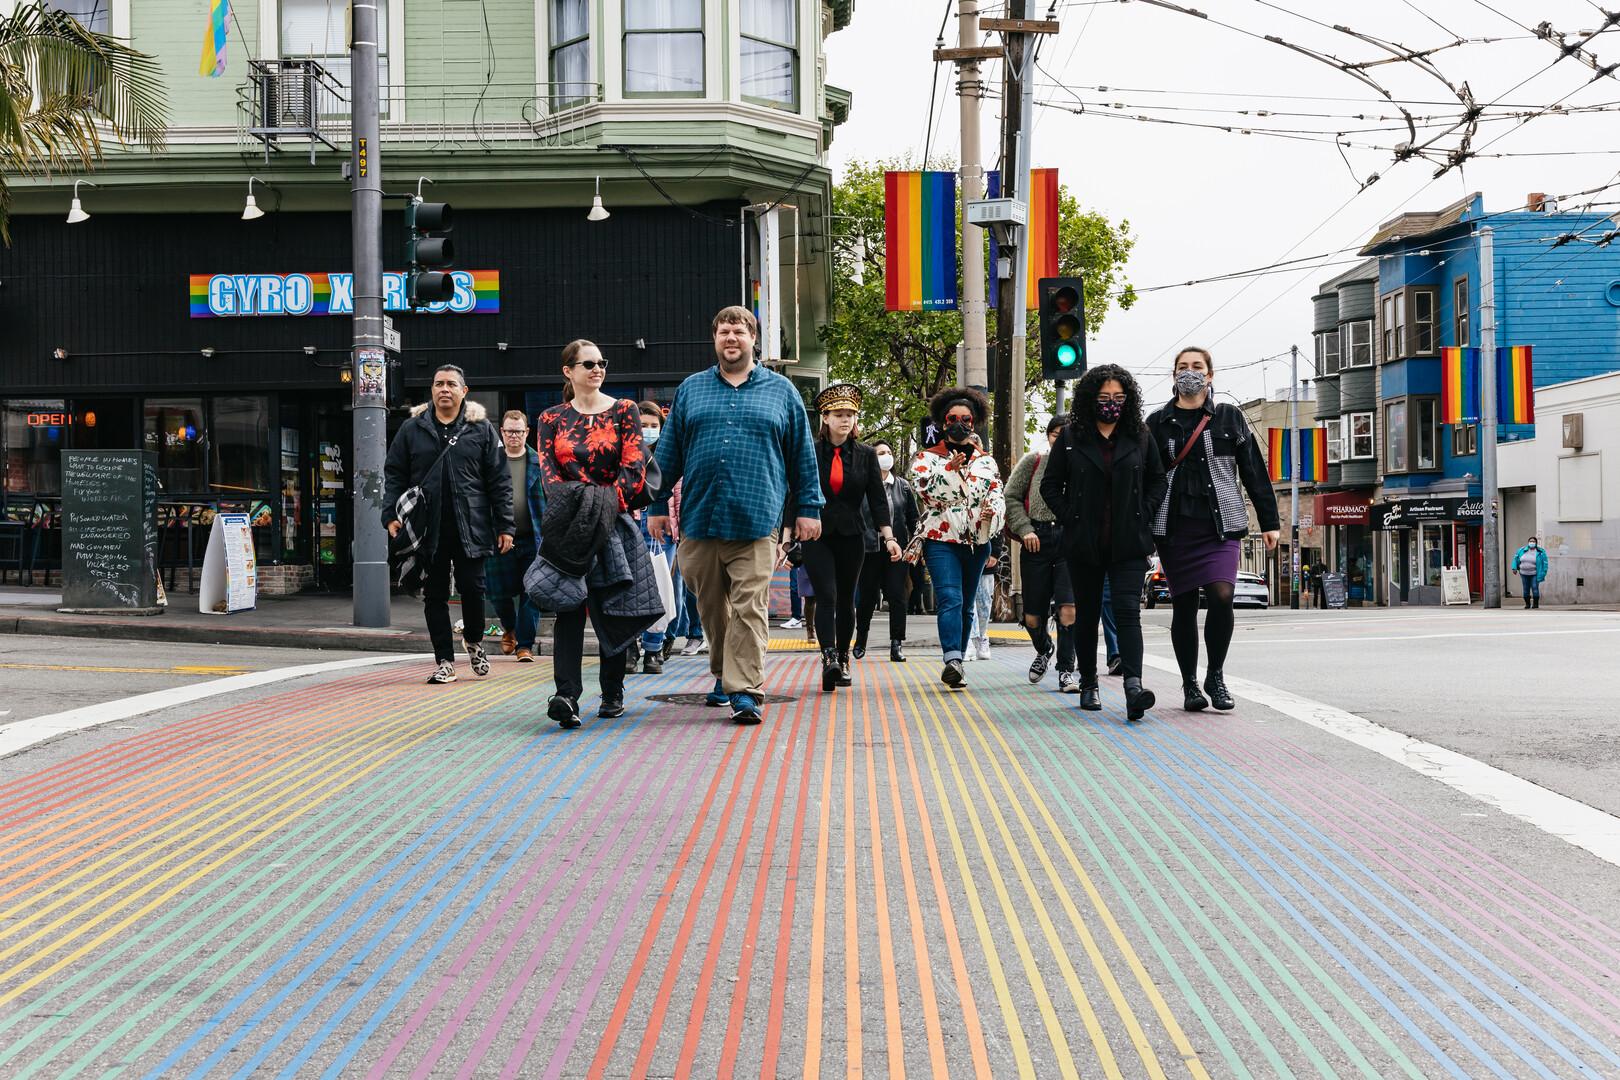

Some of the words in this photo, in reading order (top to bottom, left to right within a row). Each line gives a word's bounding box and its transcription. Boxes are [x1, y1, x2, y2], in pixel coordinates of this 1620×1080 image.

[359, 139, 367, 177] T497
[208, 273, 314, 315] GYRO
[327, 271, 476, 314] XRS
[27, 414, 72, 425] OPEN
[1332, 505, 1367, 513] PHARMACY
